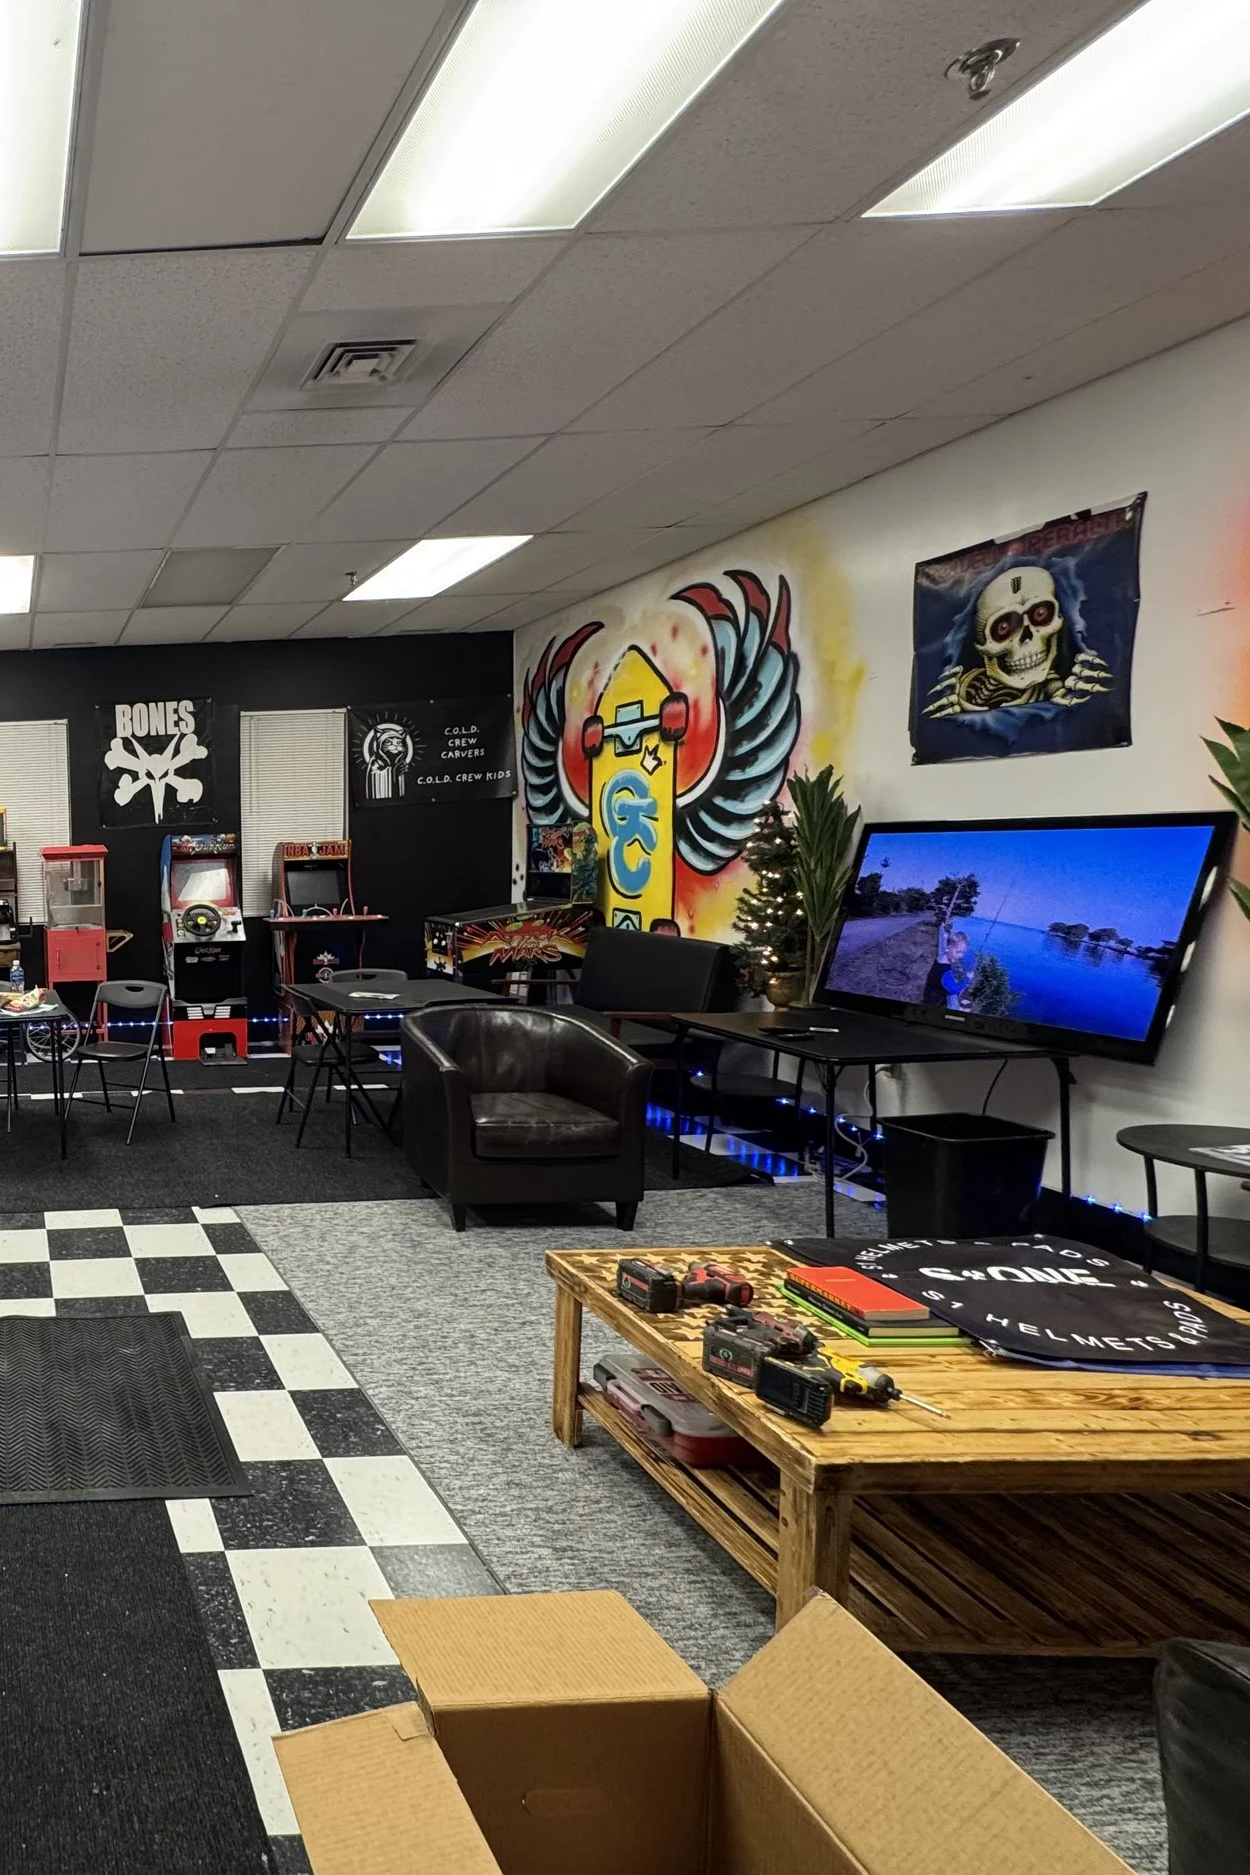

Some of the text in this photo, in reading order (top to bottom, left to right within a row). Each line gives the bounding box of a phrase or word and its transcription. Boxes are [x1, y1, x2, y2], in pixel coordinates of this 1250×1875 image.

[115, 700, 196, 738] BONES
[448, 738, 477, 747] CREW
[441, 748, 485, 759] CARVERS
[455, 773, 482, 782] CREW
[486, 770, 511, 781] KIDS
[985, 1312, 1177, 1351] HELMETS
[1162, 1299, 1209, 1340] PADS
